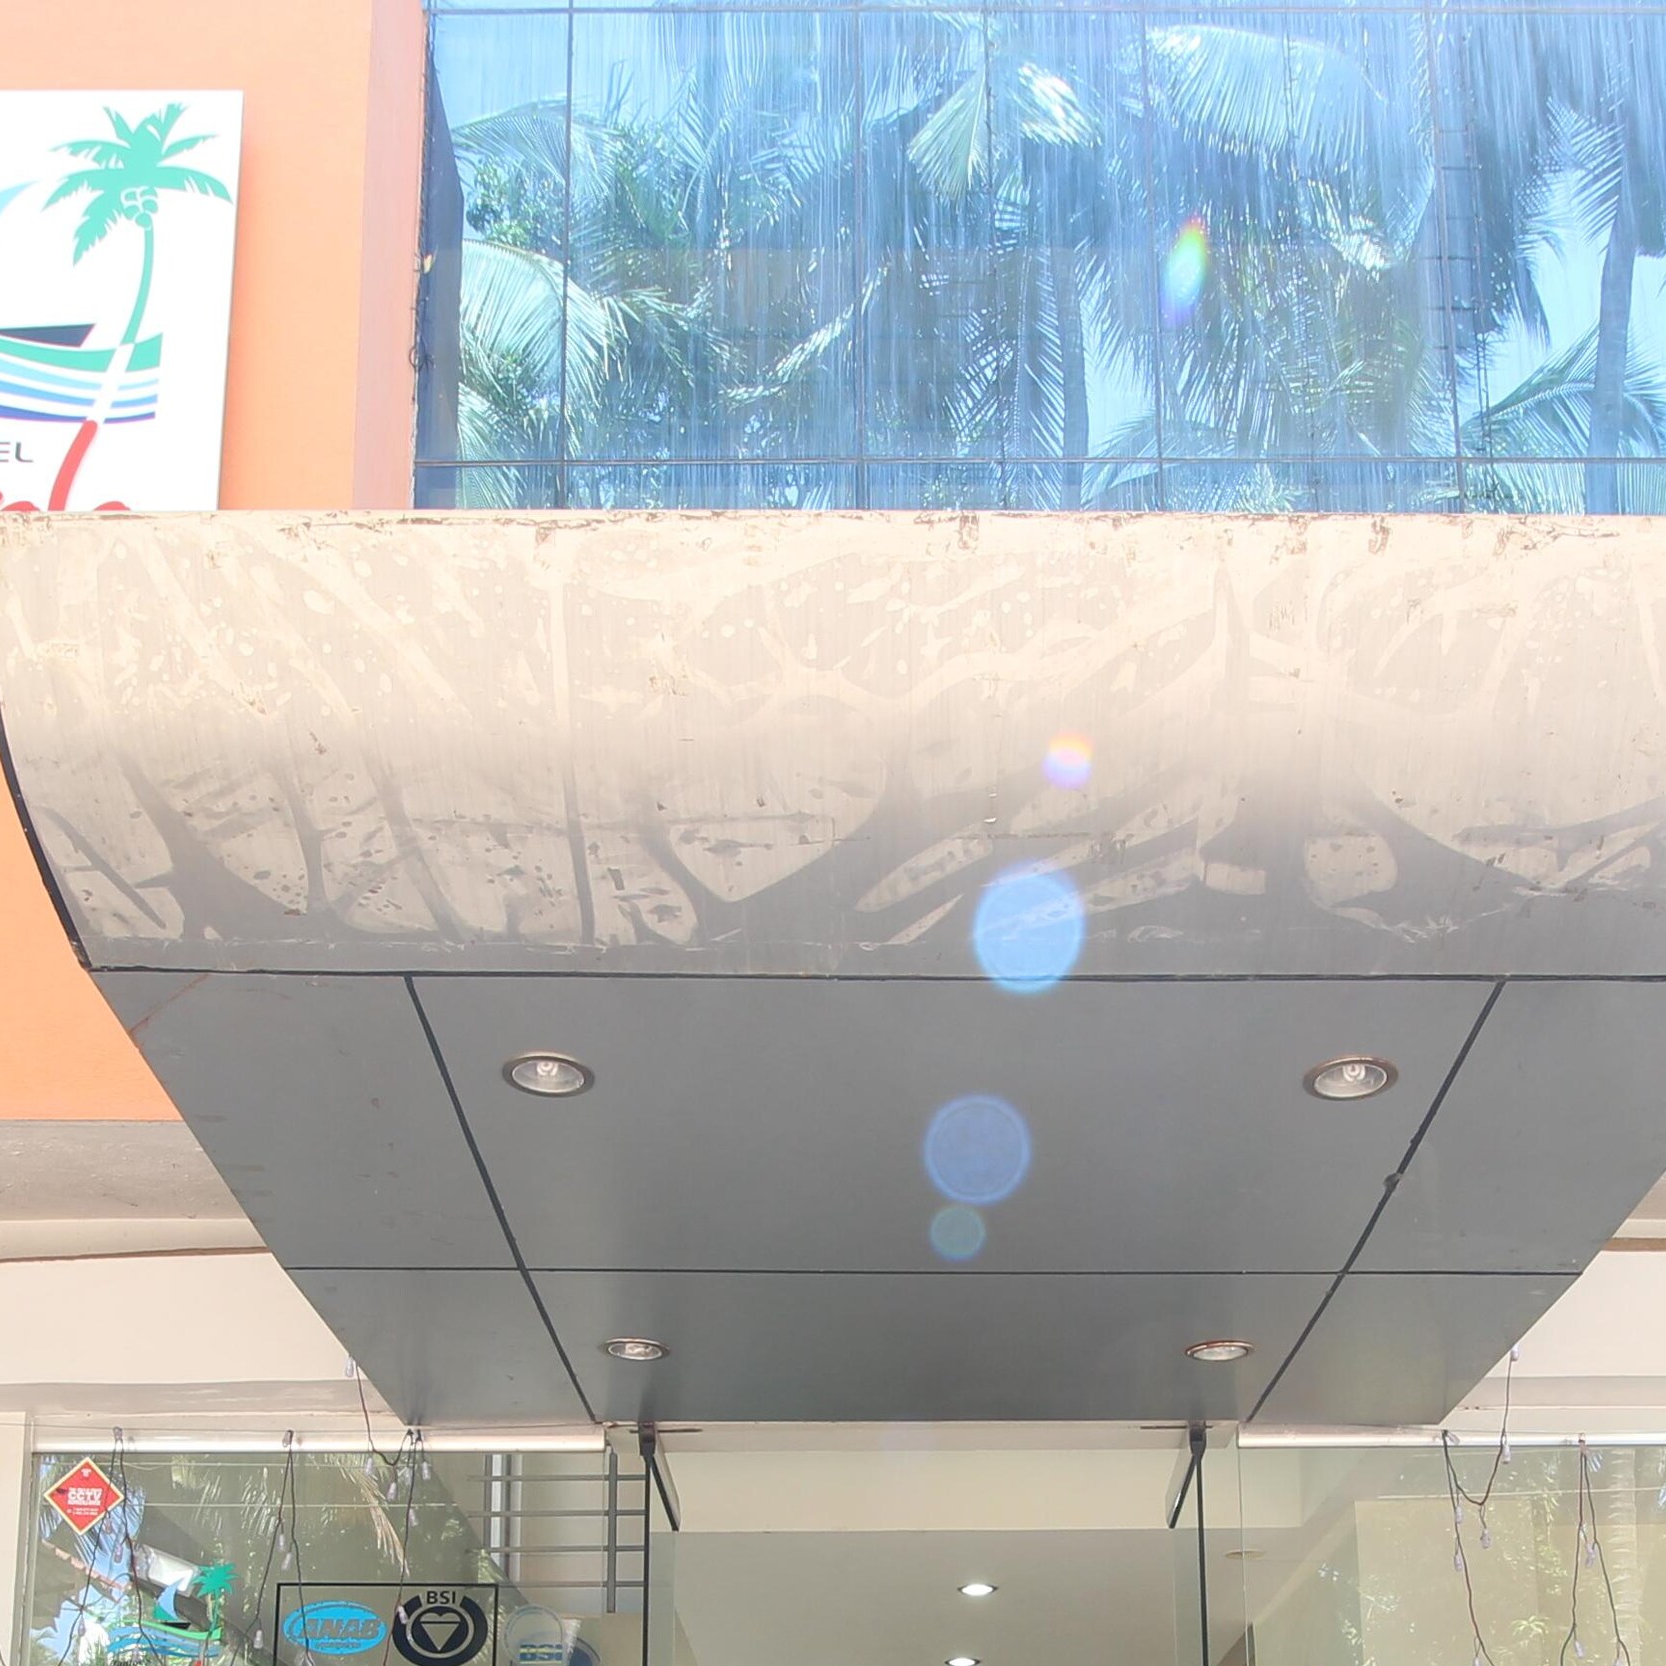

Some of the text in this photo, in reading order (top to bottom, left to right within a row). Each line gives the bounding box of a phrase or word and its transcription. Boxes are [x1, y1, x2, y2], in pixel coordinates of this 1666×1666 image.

[67, 1491, 102, 1501] CCTV
[426, 1591, 456, 1605] BSI
[300, 1618, 381, 1639] ANAB
